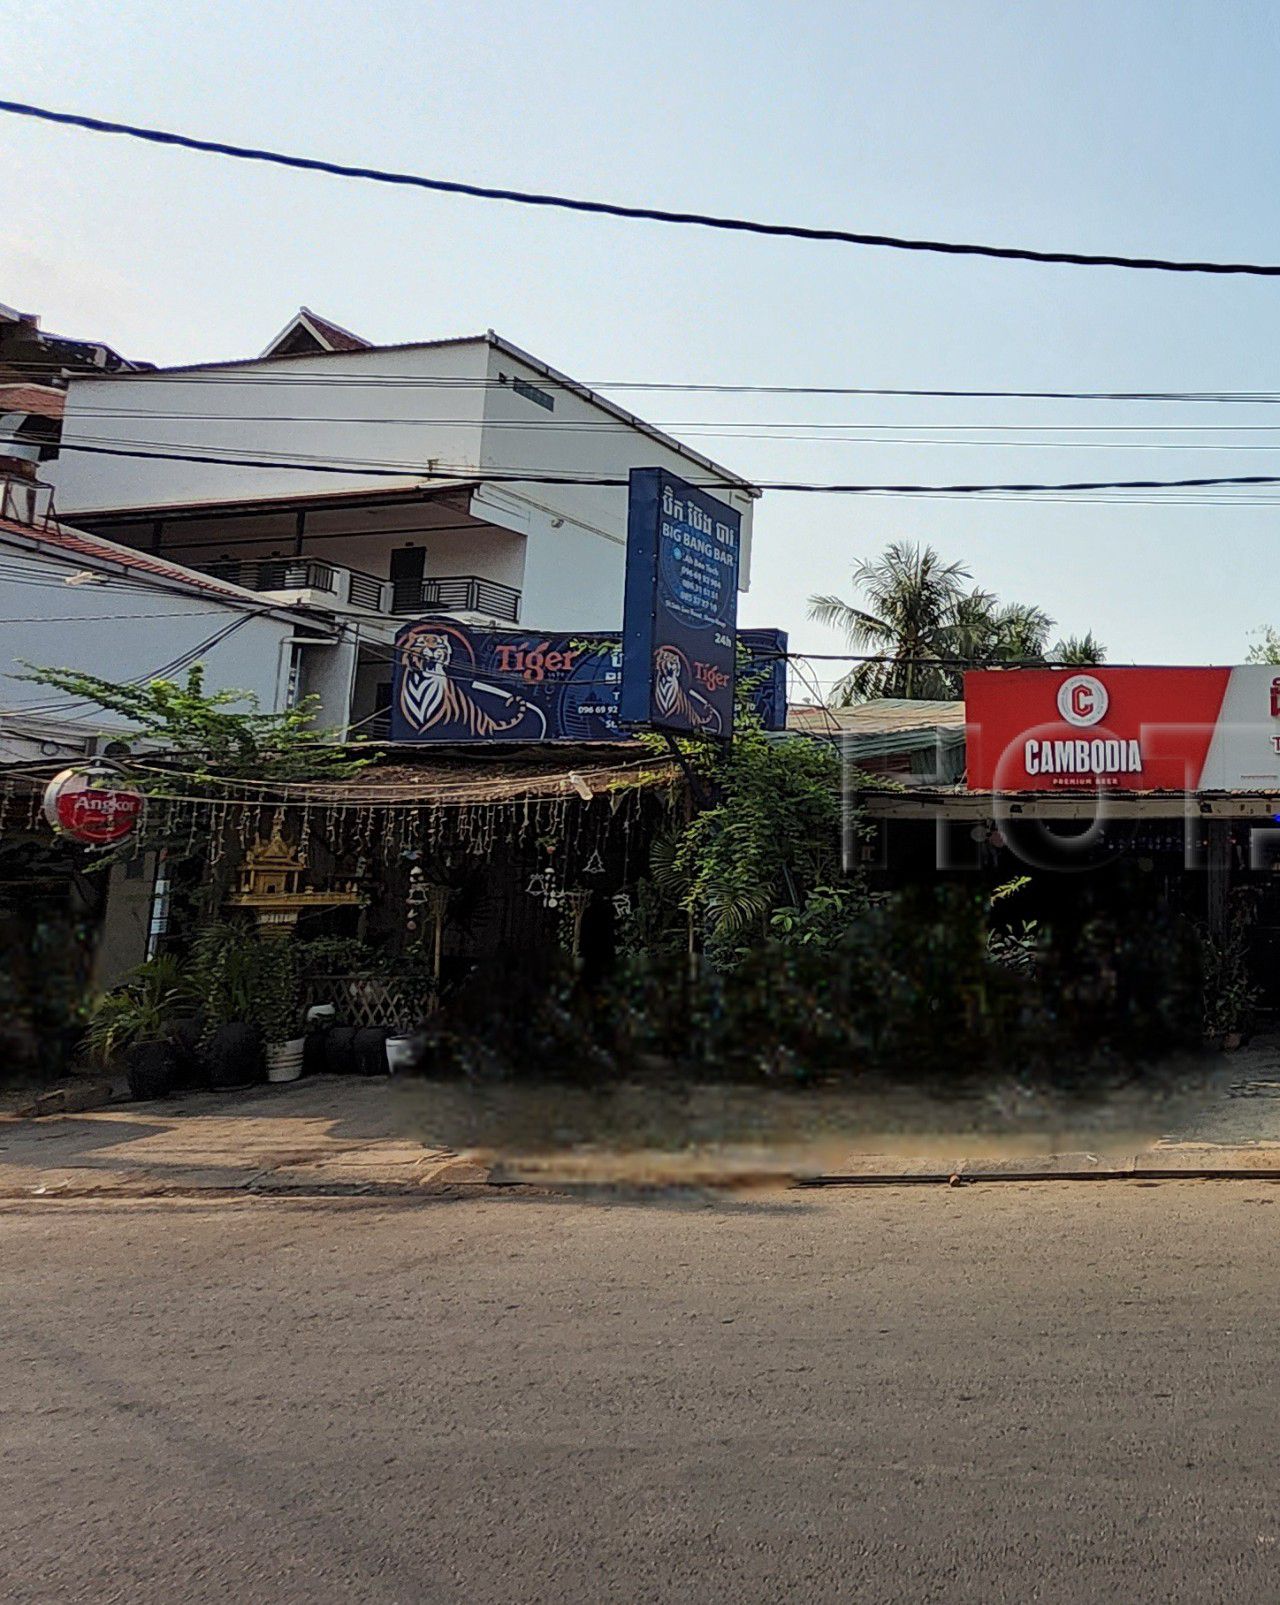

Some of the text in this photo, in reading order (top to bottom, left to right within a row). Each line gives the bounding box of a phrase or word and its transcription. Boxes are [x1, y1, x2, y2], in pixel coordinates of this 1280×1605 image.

[662, 522, 734, 571] BIG BANG BAR
[714, 632, 732, 648] 24h
[496, 641, 582, 684] Tiger
[693, 662, 730, 691] Tiger
[1025, 739, 1142, 775] CAMBODIA
[1052, 777, 1119, 786] PREMIUM BEER
[74, 796, 136, 815] Angkor
